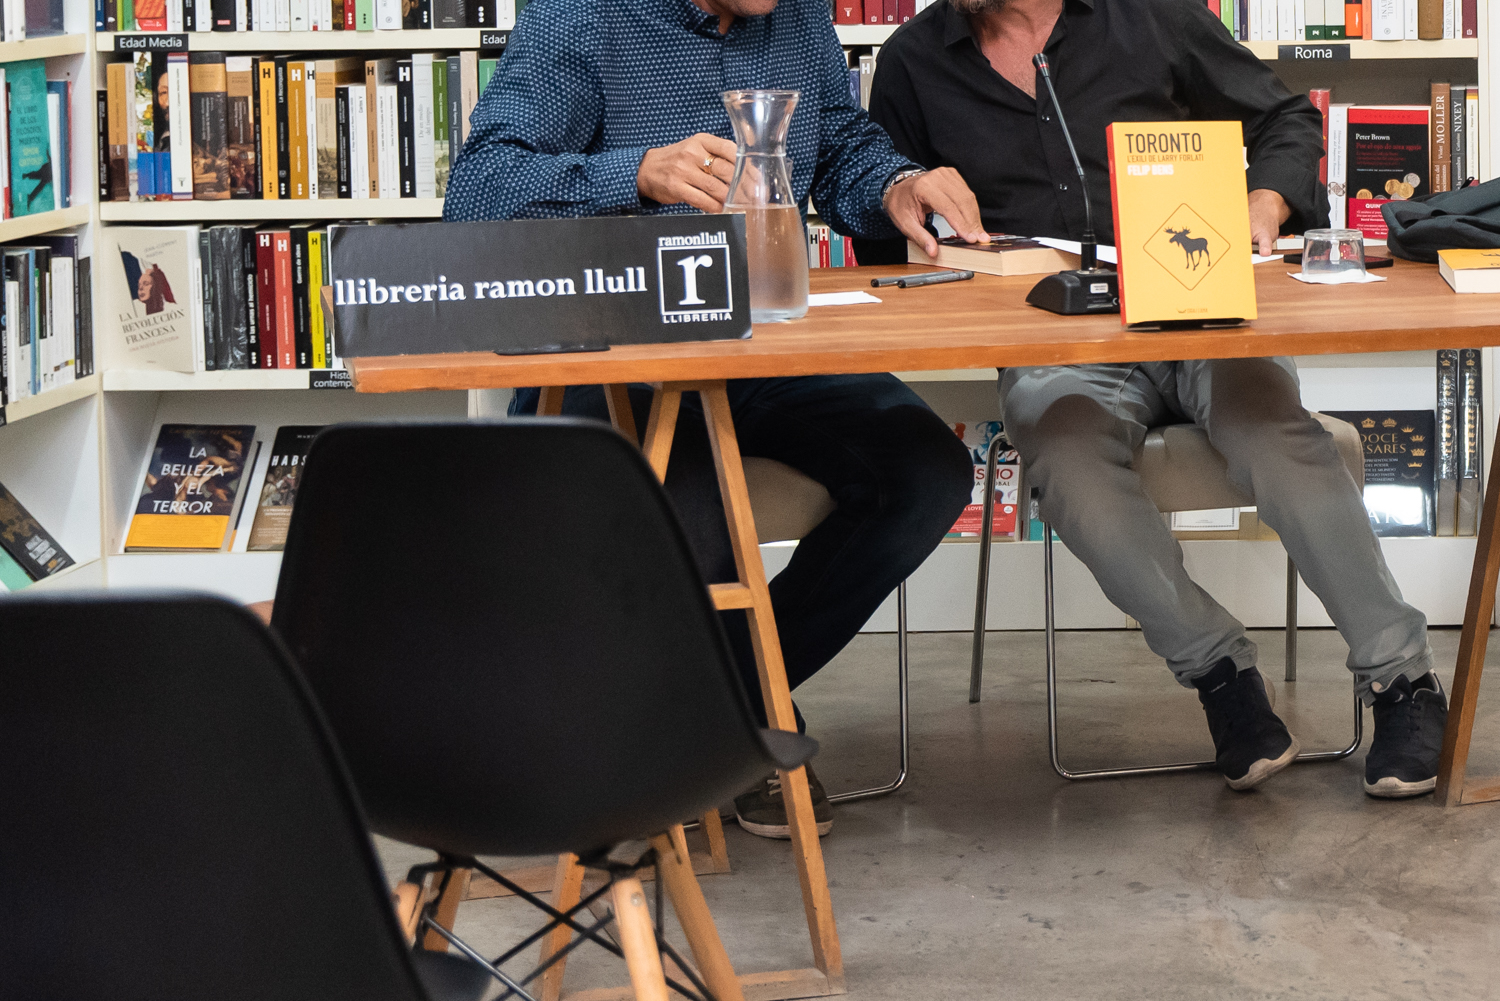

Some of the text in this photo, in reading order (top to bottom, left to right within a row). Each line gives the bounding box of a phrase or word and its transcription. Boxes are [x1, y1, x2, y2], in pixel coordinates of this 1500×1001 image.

[119, 37, 182, 47] Edad Media
[483, 35, 506, 44] Edad
[1294, 47, 1332, 59] Roma
[1436, 95, 1444, 144] MOLLER
[1125, 133, 1202, 153] TORONTO
[1127, 165, 1174, 175] FELIP BENS
[658, 232, 726, 246] ramonllull
[677, 254, 712, 305] r
[335, 266, 647, 306] llibreria ramon llull
[119, 313, 133, 322] LA
[122, 309, 184, 333] REVOLUCIÓN
[662, 313, 731, 323] LLIBRERIA
[125, 325, 176, 344] FRANCESA
[189, 447, 206, 458] LA
[161, 464, 224, 477] BELLEZA
[153, 501, 213, 513] TERROR
